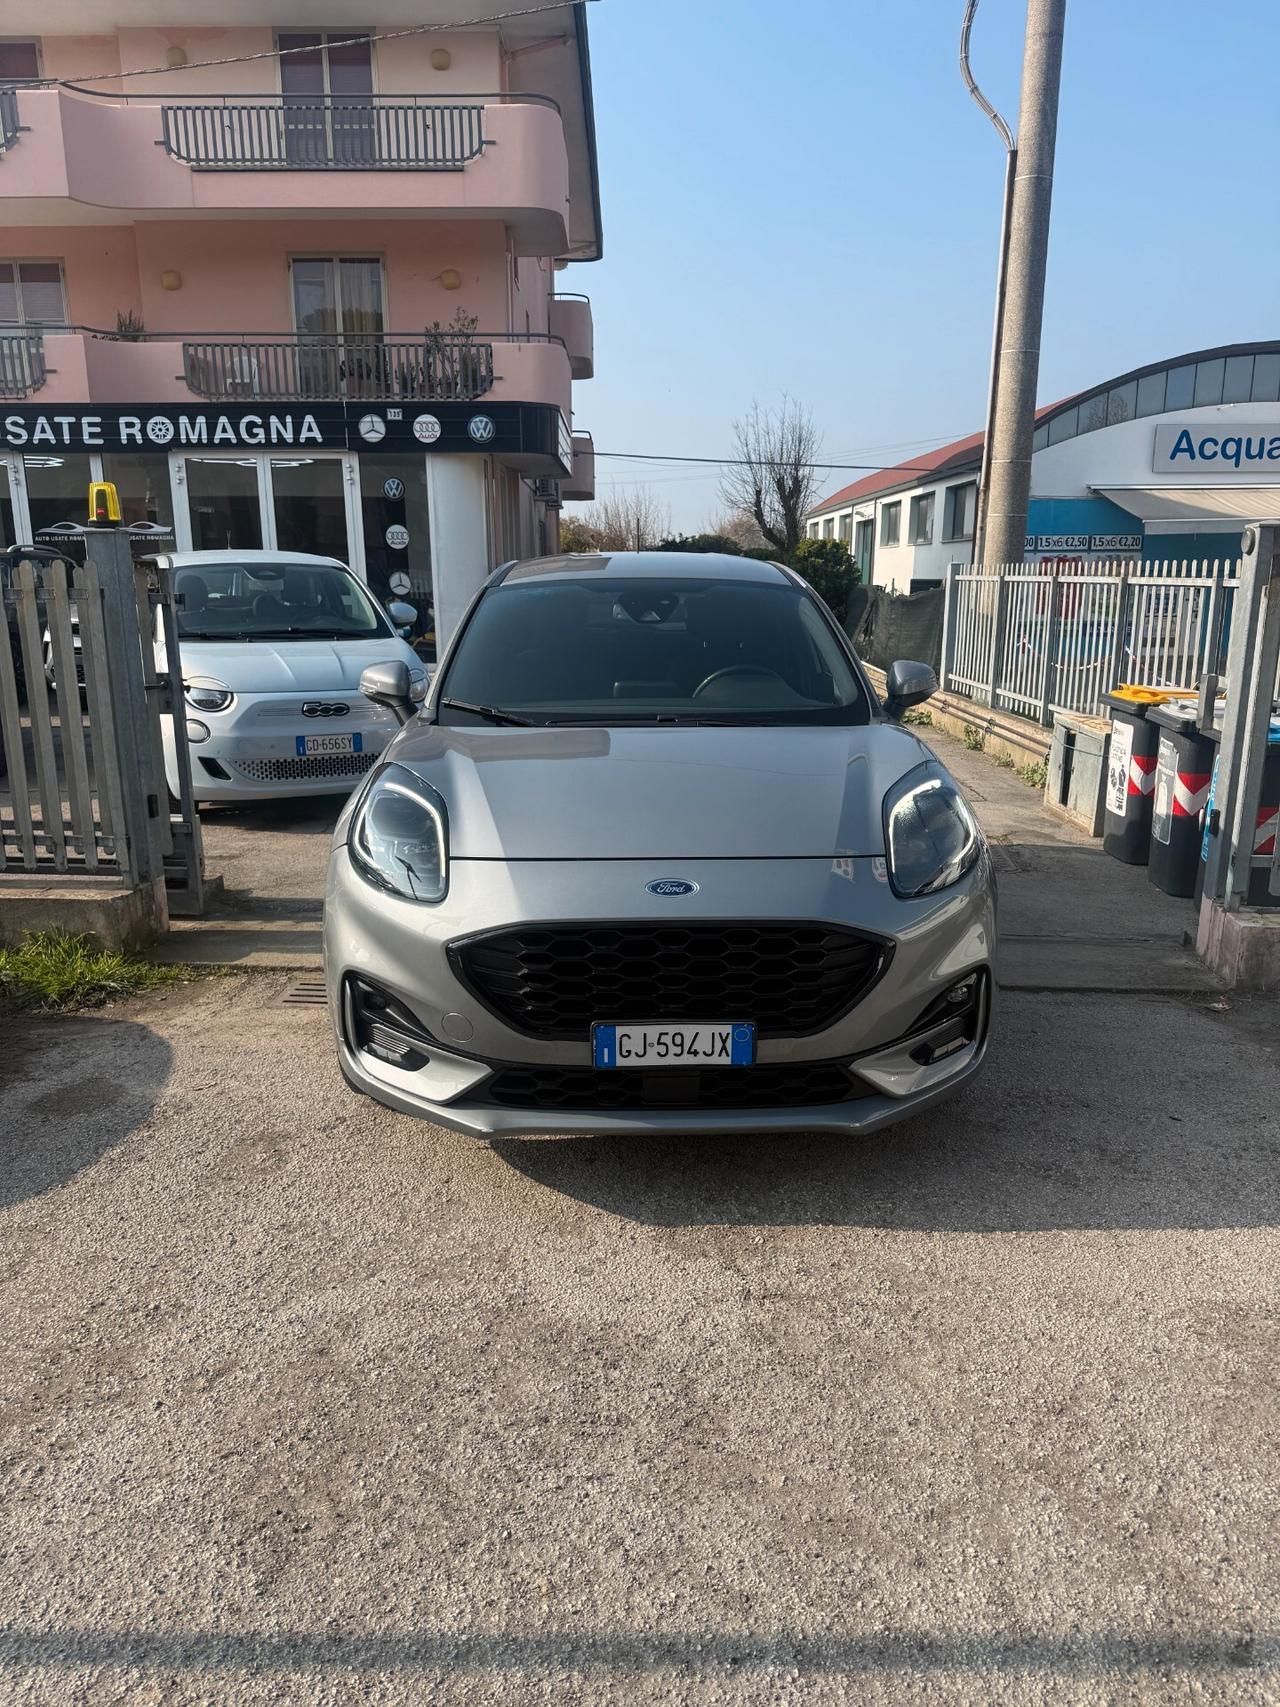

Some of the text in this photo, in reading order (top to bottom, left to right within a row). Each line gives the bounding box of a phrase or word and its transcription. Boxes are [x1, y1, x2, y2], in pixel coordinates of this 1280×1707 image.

[5, 415, 323, 445] SATE ROMAGNA
[1169, 429, 1280, 468] Acqua
[1065, 537, 1087, 548] €2,50
[1118, 537, 1140, 548] €2,20
[302, 701, 350, 718] 500
[656, 882, 686, 894] Ford
